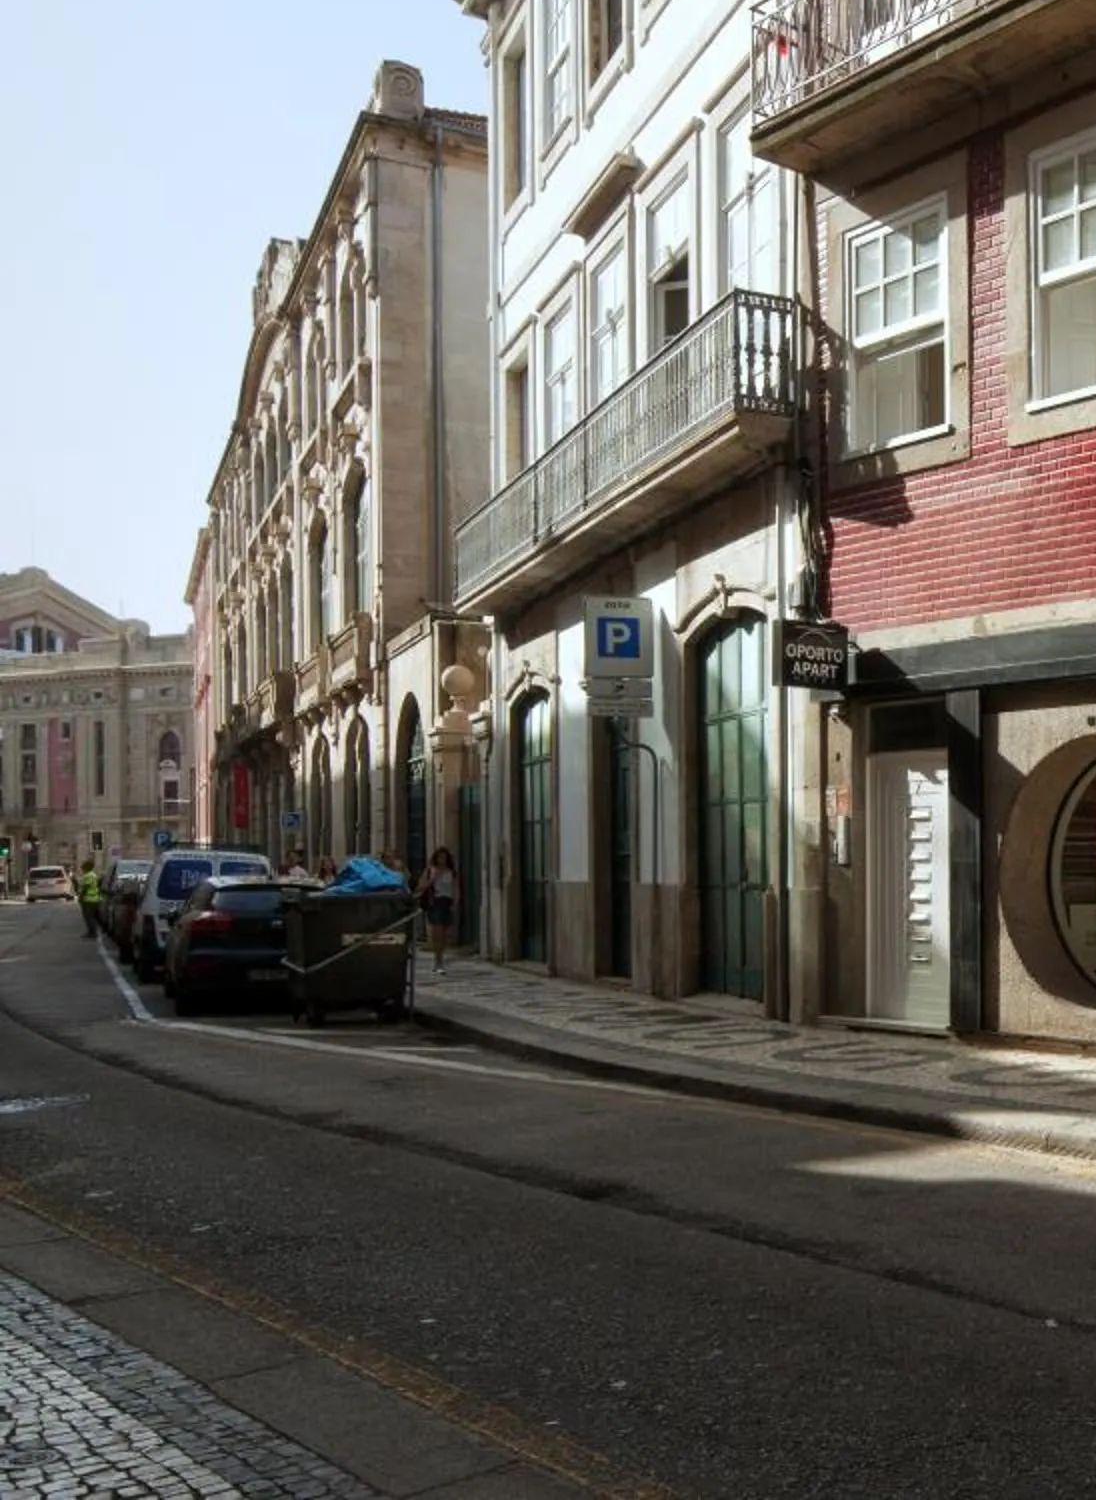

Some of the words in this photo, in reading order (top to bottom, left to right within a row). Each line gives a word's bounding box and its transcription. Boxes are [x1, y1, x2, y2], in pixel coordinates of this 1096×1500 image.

[605, 622, 631, 653] P
[785, 643, 845, 663] OPORTO
[792, 661, 839, 679] APART
